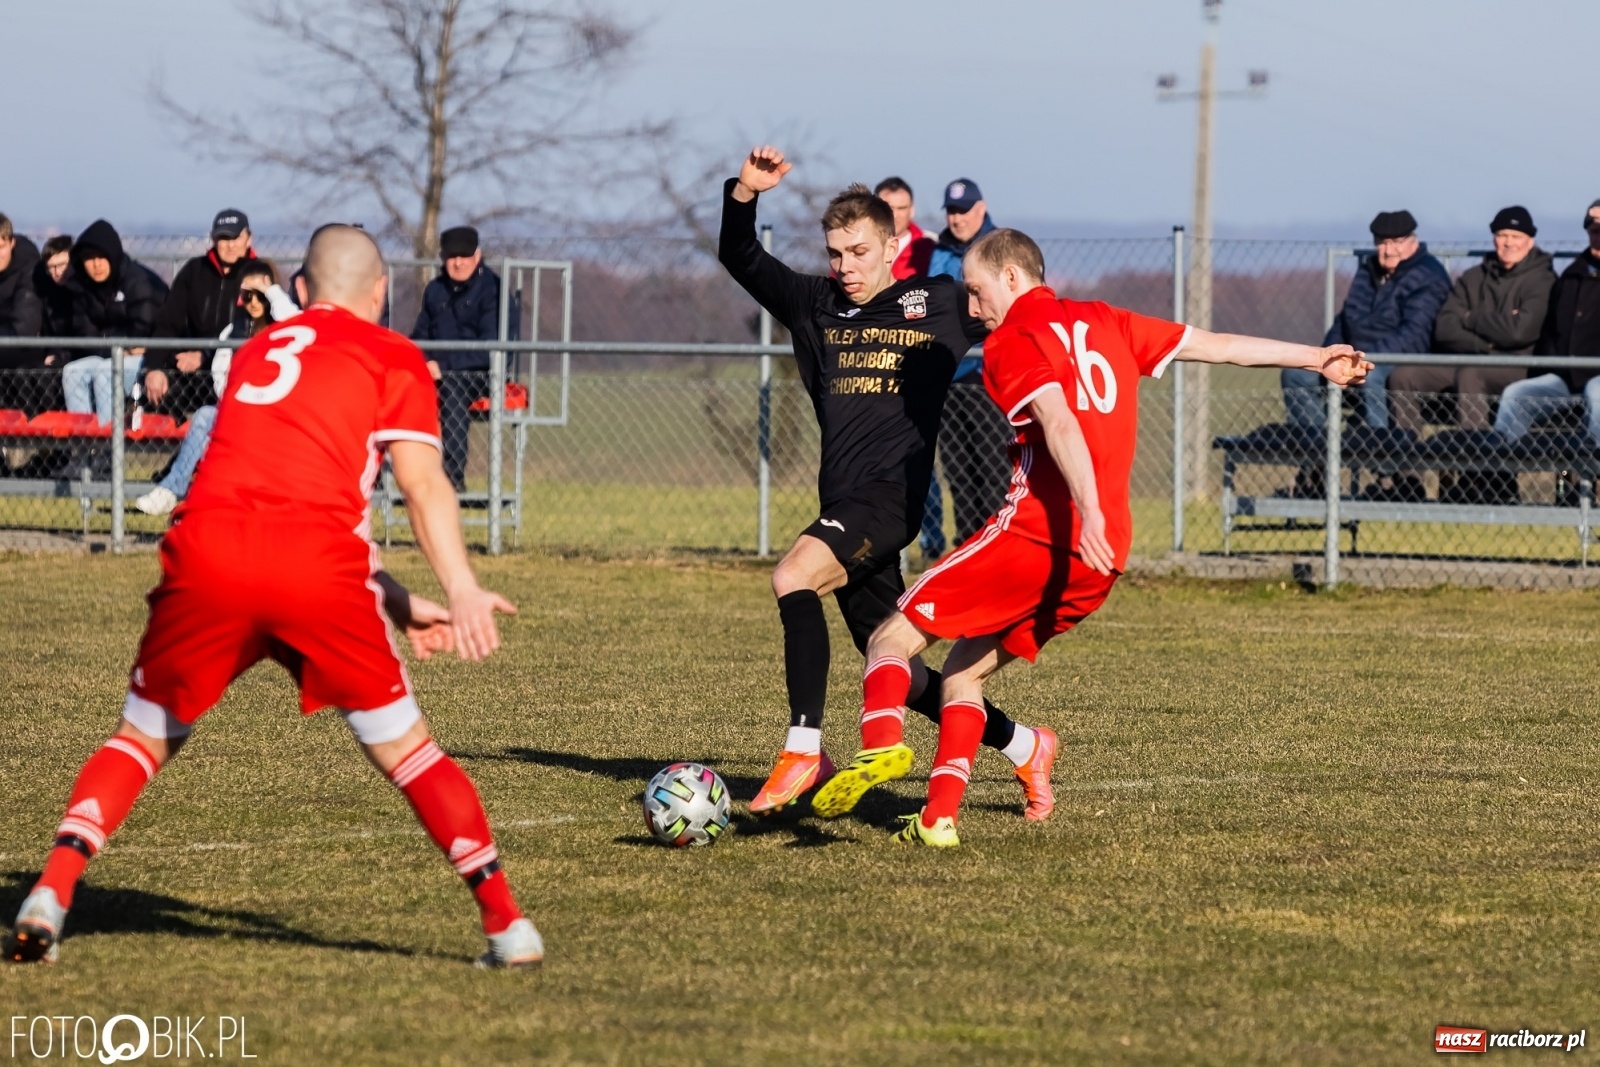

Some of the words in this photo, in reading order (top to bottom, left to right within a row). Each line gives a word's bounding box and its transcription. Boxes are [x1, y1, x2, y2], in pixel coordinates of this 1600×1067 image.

[838, 348, 905, 371] RACIBÓRZ
[861, 328, 936, 350] SPORTOWY
[234, 325, 317, 405] 3
[1048, 319, 1118, 414] 16
